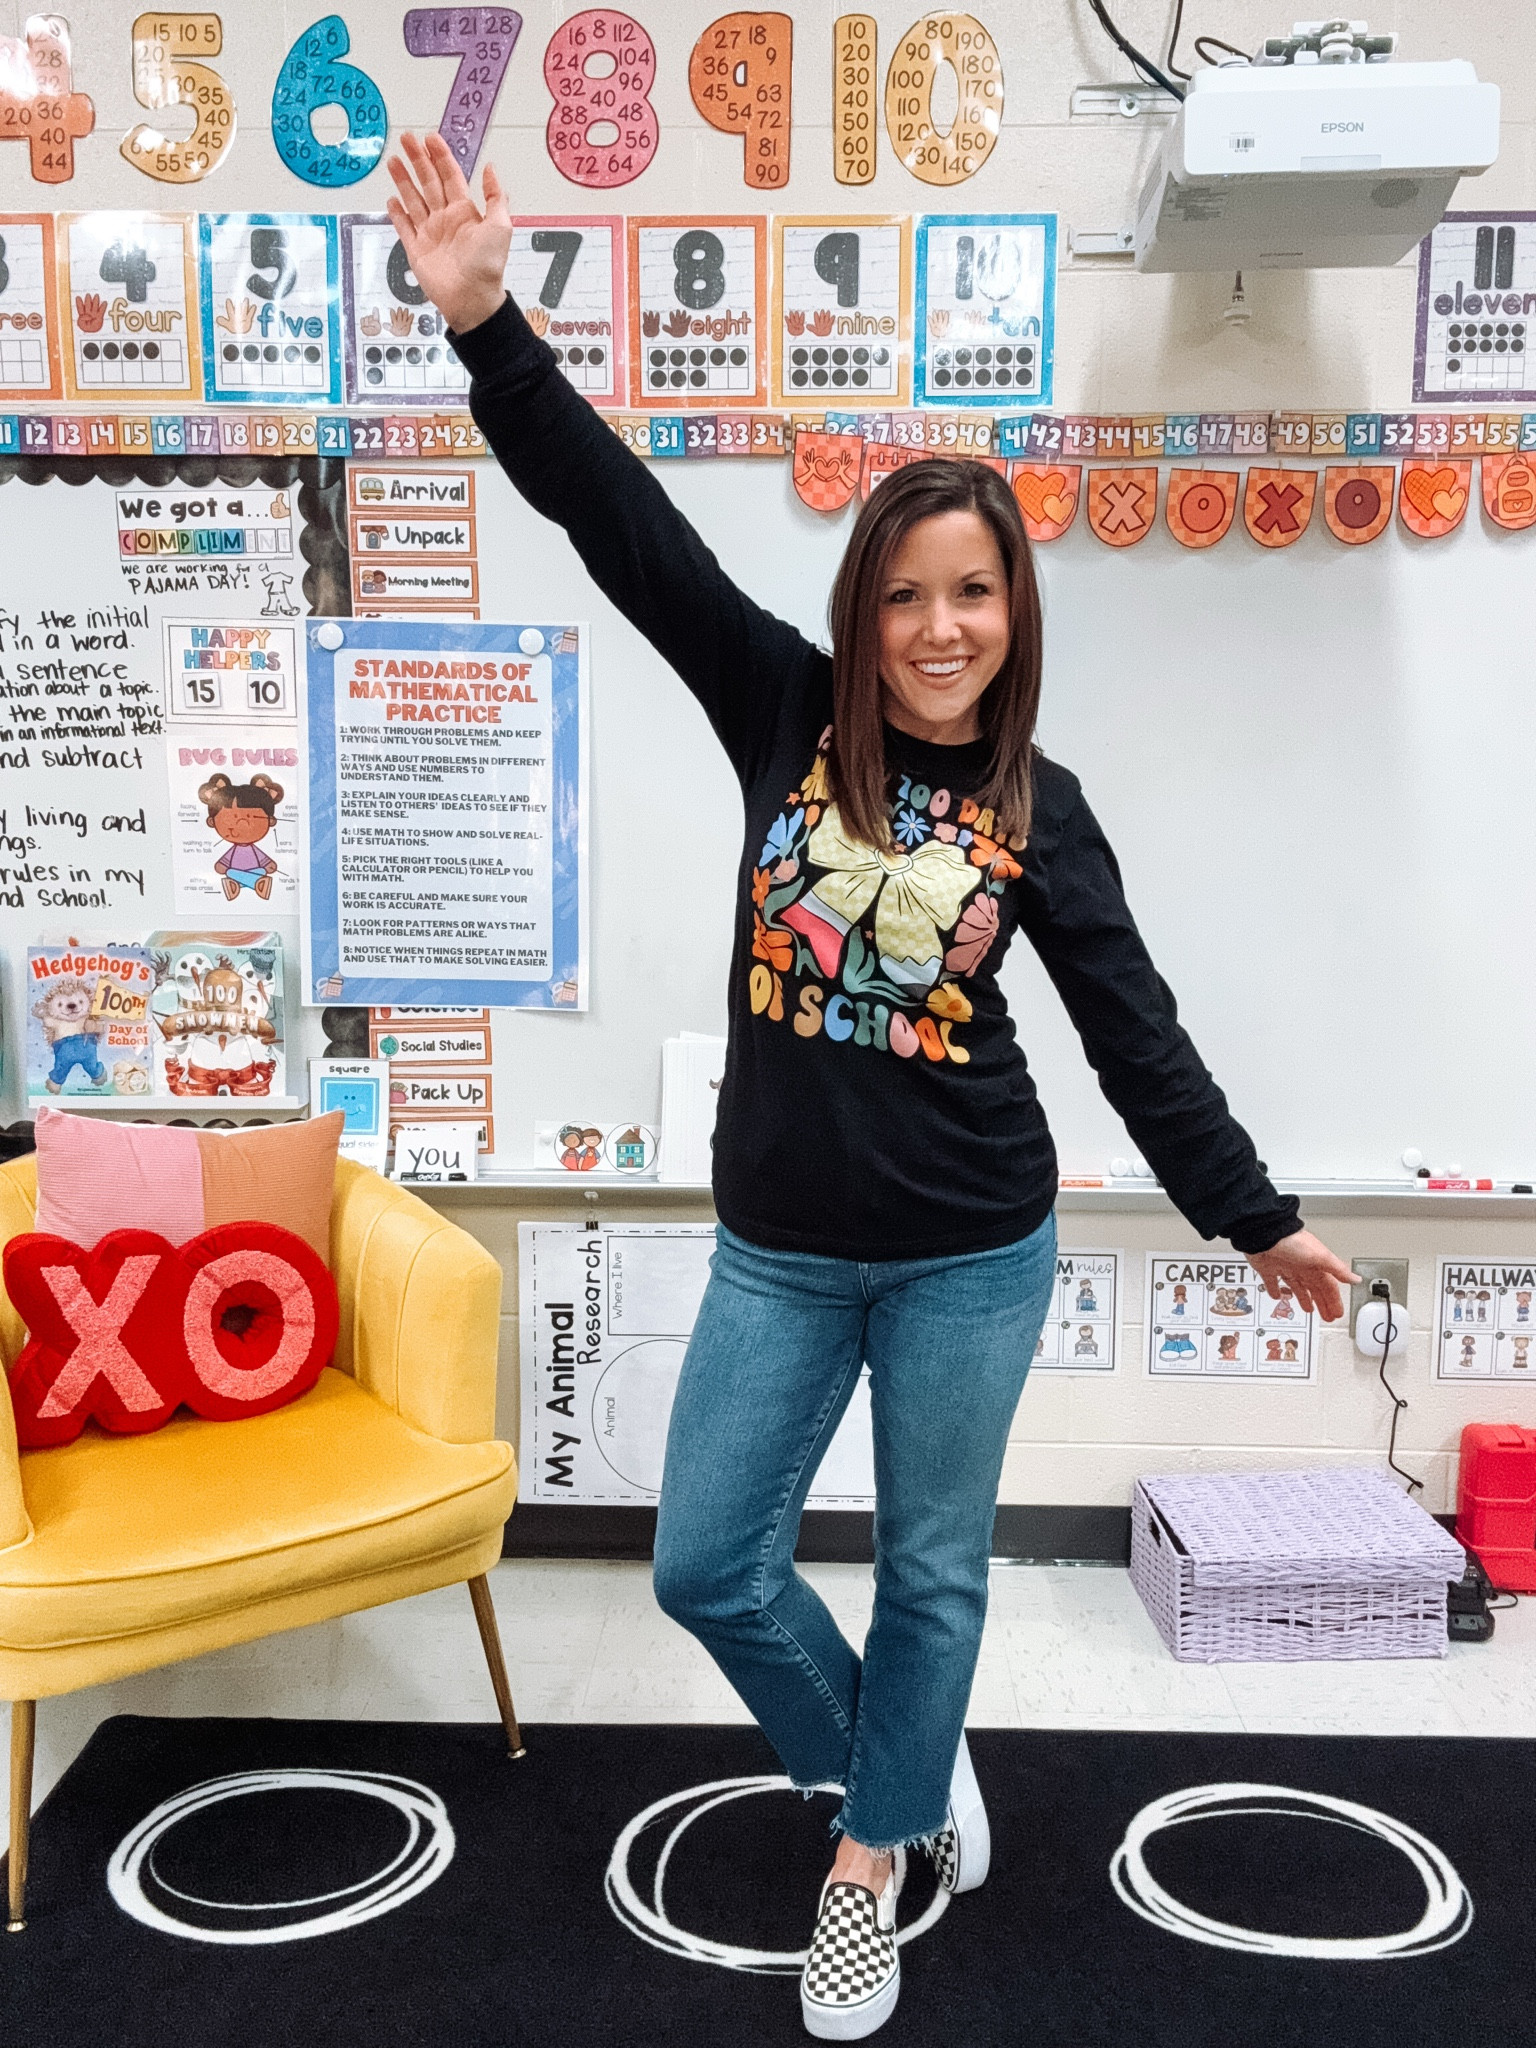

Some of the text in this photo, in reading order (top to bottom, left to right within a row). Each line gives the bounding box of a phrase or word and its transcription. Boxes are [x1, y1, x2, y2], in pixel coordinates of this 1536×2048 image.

[153, 24, 216, 42] 15 10 5
[413, 16, 512, 37] 7 14 21 28
[569, 27, 586, 45] 16
[593, 19, 605, 38] 8
[614, 23, 636, 42] 112
[848, 22, 865, 39] 10
[272, 15, 388, 188] 6
[544, 9, 659, 188] 8
[590, 90, 616, 107] 40
[688, 11, 793, 189] 9
[833, 9, 1004, 187] 10
[843, 113, 868, 130] 50
[1320, 122, 1364, 133] EPSON
[756, 164, 780, 182] 90
[844, 160, 869, 178] 70
[246, 229, 297, 299] 5
[1474, 225, 1516, 290] 11
[99, 242, 156, 303] 4
[531, 231, 583, 309] 7
[674, 229, 725, 310] 8
[814, 232, 859, 308] 9
[1434, 280, 1536, 315] eleven
[0, 310, 43, 331] ree
[108, 302, 182, 333] four
[256, 305, 324, 339] five
[549, 314, 612, 337] seven
[690, 309, 751, 341] eight
[836, 309, 895, 336] nine
[25, 422, 485, 449] 12 13 14 18 19 20 21 23 24 25
[687, 423, 749, 448] 32 33
[1313, 422, 1415, 446] 50 51 52
[390, 479, 465, 502] Arrival
[119, 498, 162, 518] We
[170, 498, 218, 523] got
[1100, 478, 1381, 534] X O X O
[395, 526, 465, 549] Unpack
[146, 564, 168, 573] are
[175, 563, 228, 576] working
[128, 573, 250, 594] PAJAMA DAY!
[388, 576, 470, 589] Morning Meeting
[37, 610, 76, 628] the
[87, 605, 149, 628] initial
[12, 630, 135, 652] in a word.
[190, 628, 271, 649] HAPPY
[17, 659, 128, 681] sentence
[184, 650, 281, 671] HELPERS
[354, 659, 532, 681] STANDARDS OF
[45, 680, 90, 696] about
[100, 683, 112, 698] a
[117, 681, 159, 701] topic.
[186, 679, 280, 704] 15 10
[349, 681, 538, 703] MATHEMATICAL
[9, 702, 164, 723] the main topic
[386, 704, 502, 723] PRACTICE
[0, 720, 166, 742] in an informational text.
[341, 735, 501, 747] TRYING UNTIL YOU SOLVE THEM.
[349, 726, 380, 734] WORK
[384, 727, 432, 736] THROUGH
[434, 728, 490, 737] PROBLEMS
[492, 729, 514, 738] AND
[515, 730, 541, 738] KEEP
[0, 746, 143, 770] nd subtract
[26, 805, 87, 837] living
[101, 809, 146, 834] and
[69, 865, 91, 882] in
[105, 868, 145, 896] my
[343, 946, 547, 958] 8: NOTICE WHEN THINGS REPEAT IN MATH
[344, 955, 548, 967] AND USE THAT TO MAKE SOLVING EASIER.
[31, 953, 150, 981] Hedgehog's
[207, 985, 237, 1004] 100
[108, 1024, 148, 1037] Day of
[175, 1013, 260, 1031] SNOWMEN
[793, 984, 971, 1064] SCHOOL
[108, 1036, 148, 1046] School
[401, 1039, 482, 1052] Social Studies
[329, 1064, 370, 1075] square
[411, 1083, 484, 1104] Pack Up
[407, 1147, 460, 1173] you
[612, 1251, 622, 1268] live
[1077, 1261, 1114, 1276] rules
[1165, 1263, 1248, 1284] CARPET
[1447, 1267, 1536, 1287] HALLWA
[576, 1239, 602, 1365] Research
[612, 1281, 623, 1320] Where
[544, 1303, 581, 1488] My Animal
[603, 1396, 615, 1438] Animal
